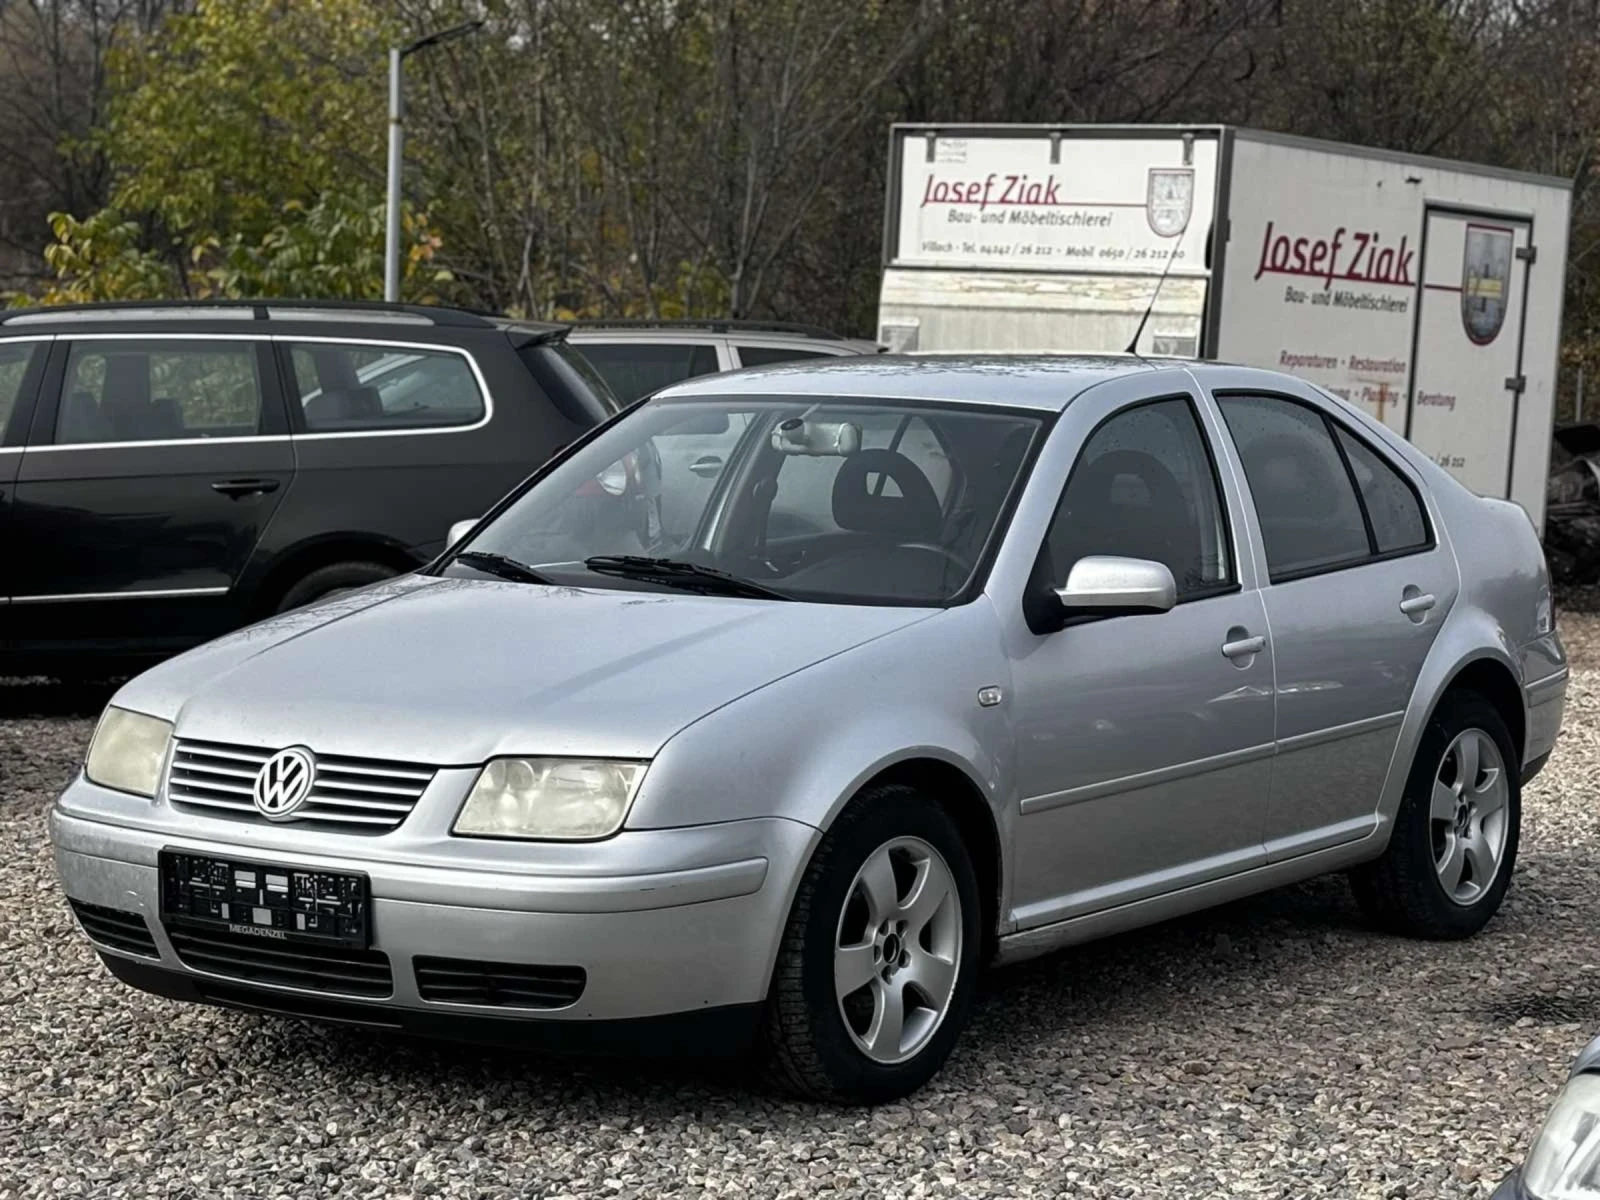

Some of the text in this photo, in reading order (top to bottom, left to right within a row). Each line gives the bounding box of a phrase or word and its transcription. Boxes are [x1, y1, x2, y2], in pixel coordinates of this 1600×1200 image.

[920, 173, 1062, 212] Josef Ziak
[947, 209, 1114, 227] Bau- und Möbeltischlerei
[1065, 245, 1096, 258] Mobil
[1254, 221, 1414, 291] Josef Ziak
[1284, 285, 1409, 313] Bau- und Möbeltischlerei
[1280, 349, 1337, 371] Reparaturen
[229, 923, 288, 940] MEGADENZEL
